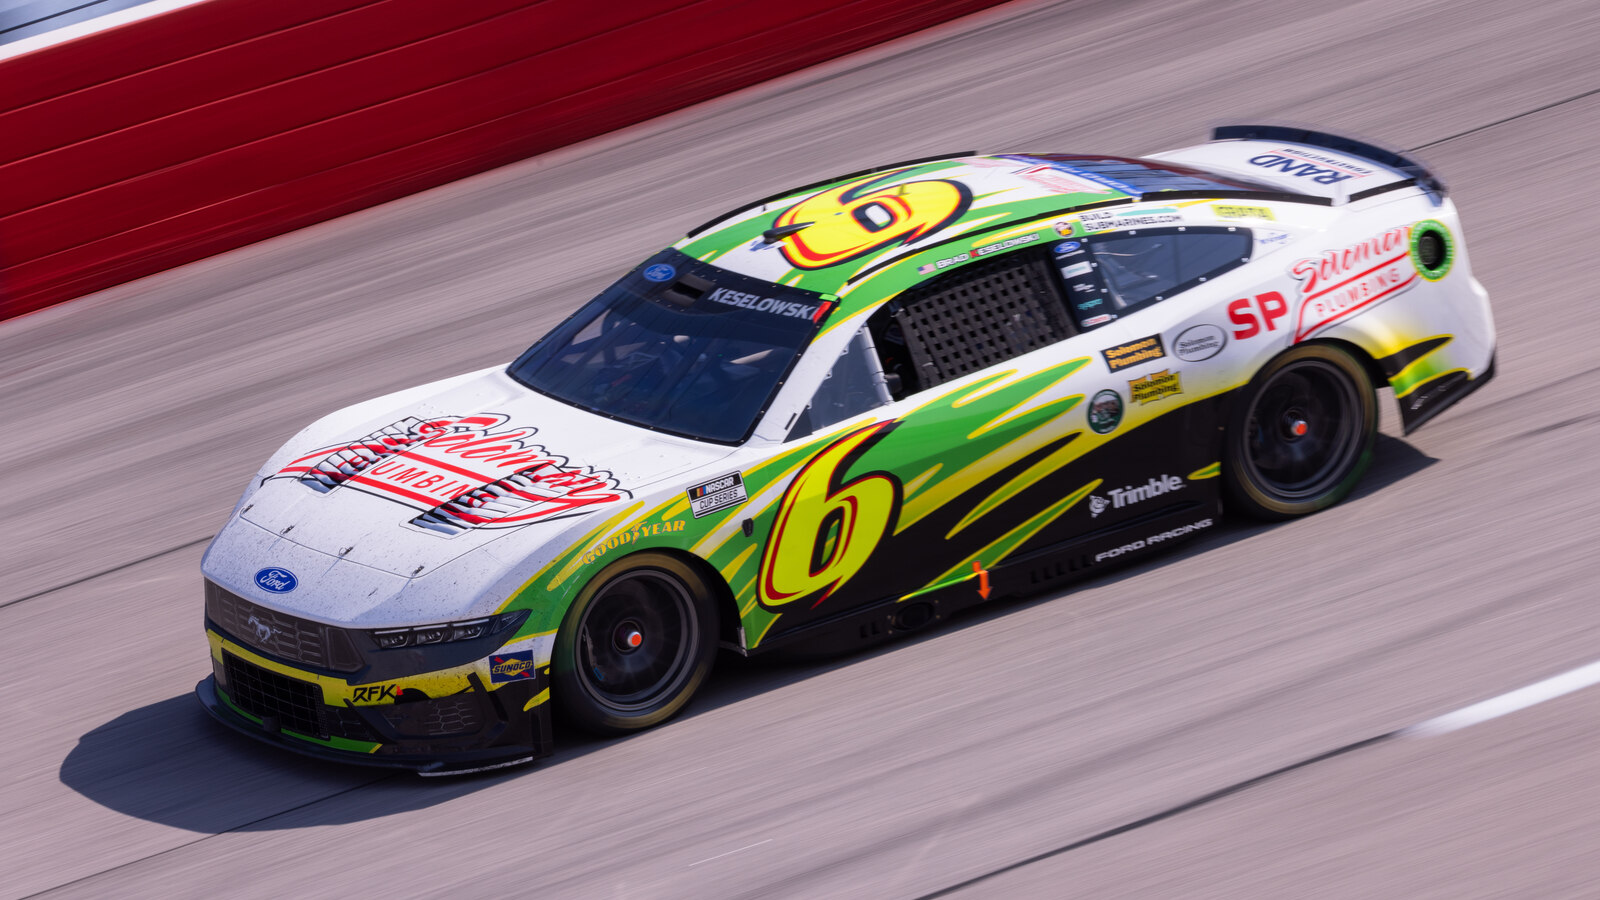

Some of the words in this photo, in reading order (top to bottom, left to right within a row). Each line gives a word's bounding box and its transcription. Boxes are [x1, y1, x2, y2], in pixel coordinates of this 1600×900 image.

[1249, 154, 1353, 185] RAND
[772, 167, 974, 271] 6
[936, 253, 969, 270] BRAD
[708, 287, 820, 321] KESELOWSKI
[1227, 290, 1289, 341] SP
[1105, 338, 1157, 359] Solomon
[1108, 346, 1164, 369] Plumbing
[705, 476, 735, 495] NASCAR
[1106, 473, 1184, 509] Trimble
[699, 497, 714, 509] CUP
[714, 489, 738, 504] SERIES
[756, 418, 906, 614] 6
[1095, 539, 1146, 562] FORD
[1146, 518, 1213, 545] RACING
[260, 570, 289, 591] Ford
[492, 659, 534, 674] SUNOCO
[353, 684, 397, 703] RFK
